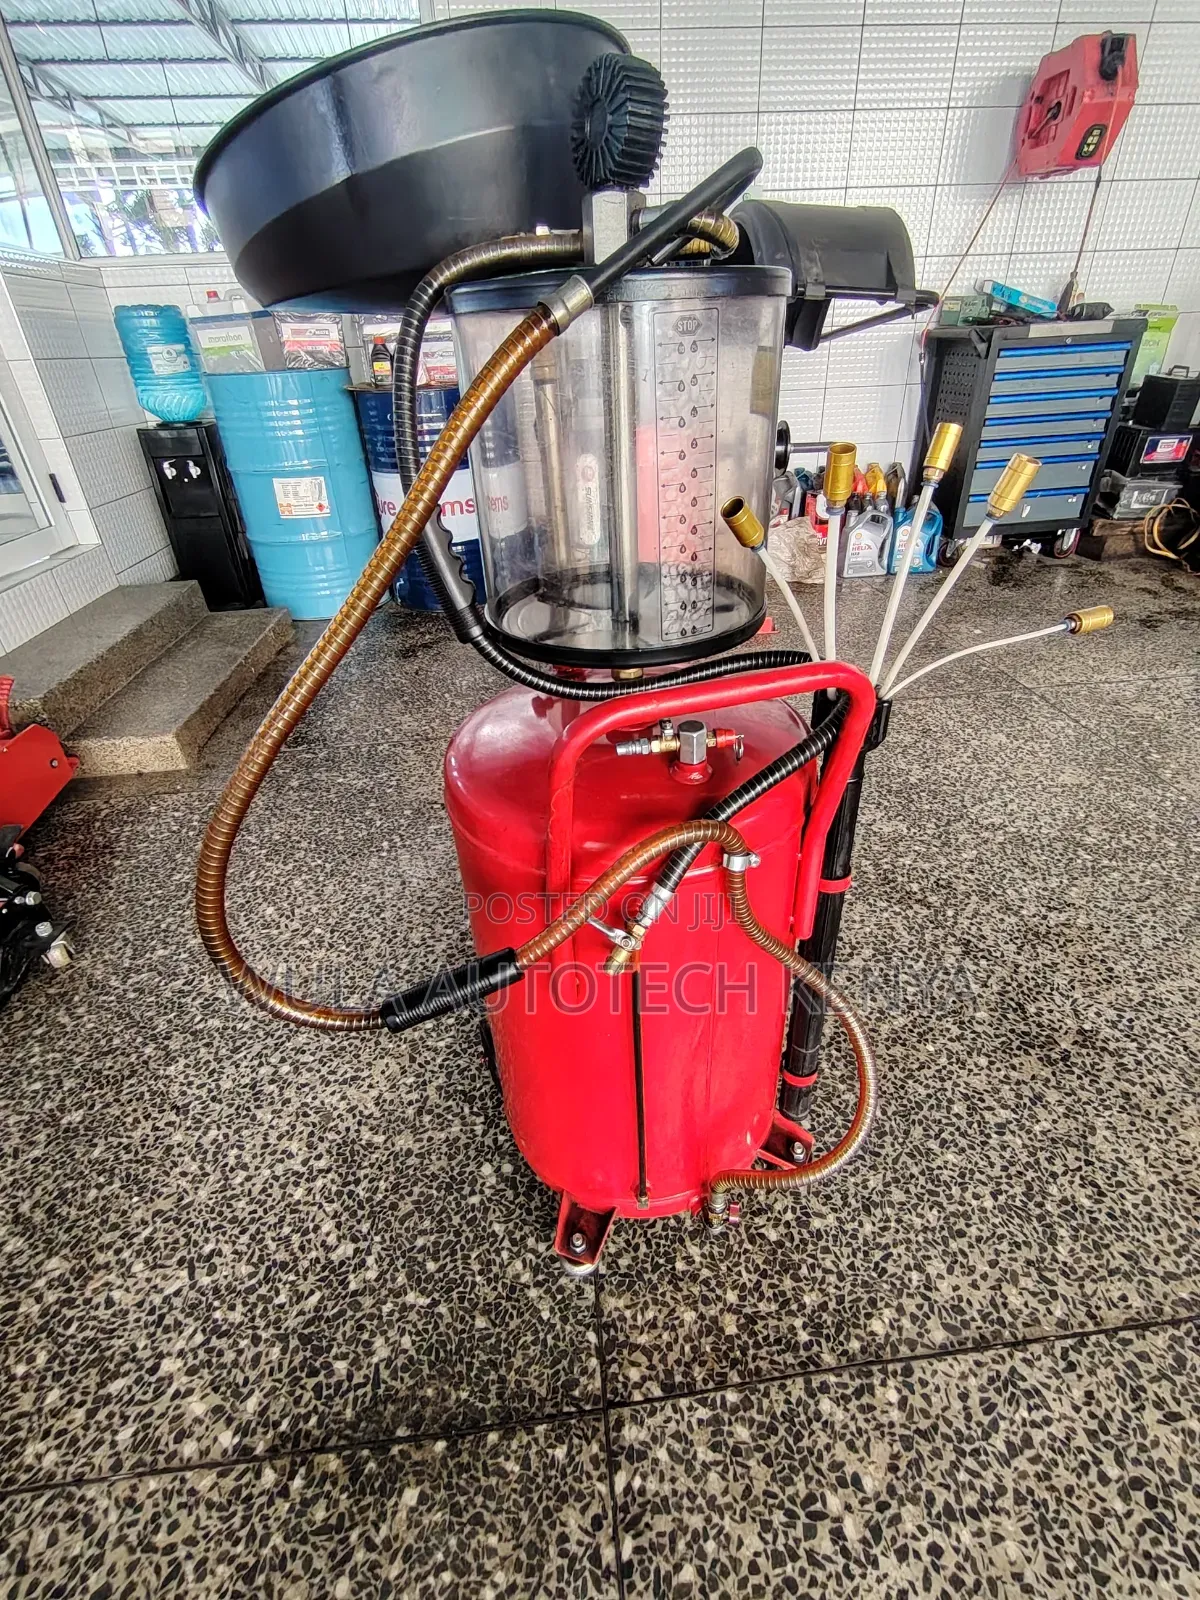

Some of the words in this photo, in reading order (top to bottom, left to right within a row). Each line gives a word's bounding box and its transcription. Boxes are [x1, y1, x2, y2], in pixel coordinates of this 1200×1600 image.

[677, 319, 698, 332] STOP
[208, 332, 243, 344] marathon
[851, 543, 873, 552] HELIX
